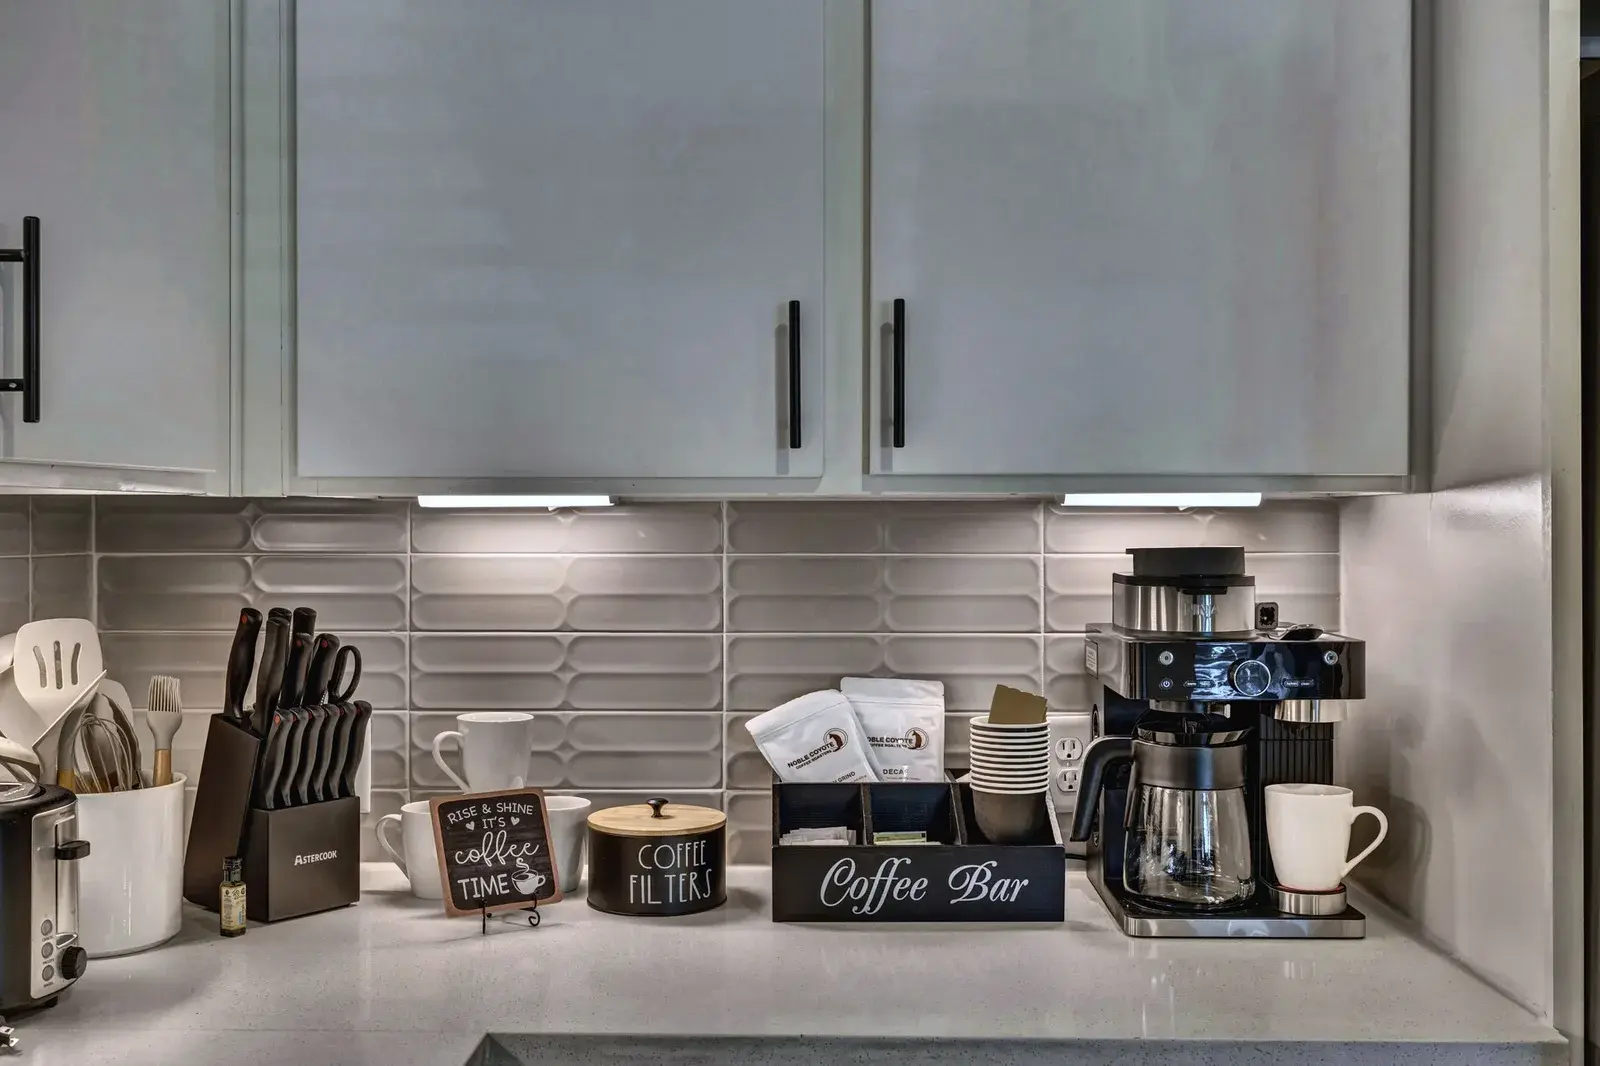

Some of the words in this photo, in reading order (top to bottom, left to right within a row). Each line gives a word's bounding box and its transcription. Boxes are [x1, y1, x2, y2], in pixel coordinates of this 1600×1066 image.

[787, 754, 810, 768] NOBLE
[809, 741, 835, 757] COYOTE
[837, 771, 856, 783] GRIND
[447, 805, 478, 824] RISE
[481, 803, 492, 814] &
[496, 802, 534, 815] SHINE
[481, 816, 506, 829] IT'S
[294, 850, 338, 866] ASTERCOOK
[455, 829, 540, 867] coffee
[638, 840, 706, 869] COFFEE
[457, 873, 510, 900] TIME
[820, 857, 929, 915] Coffee
[948, 860, 1029, 904] Bar
